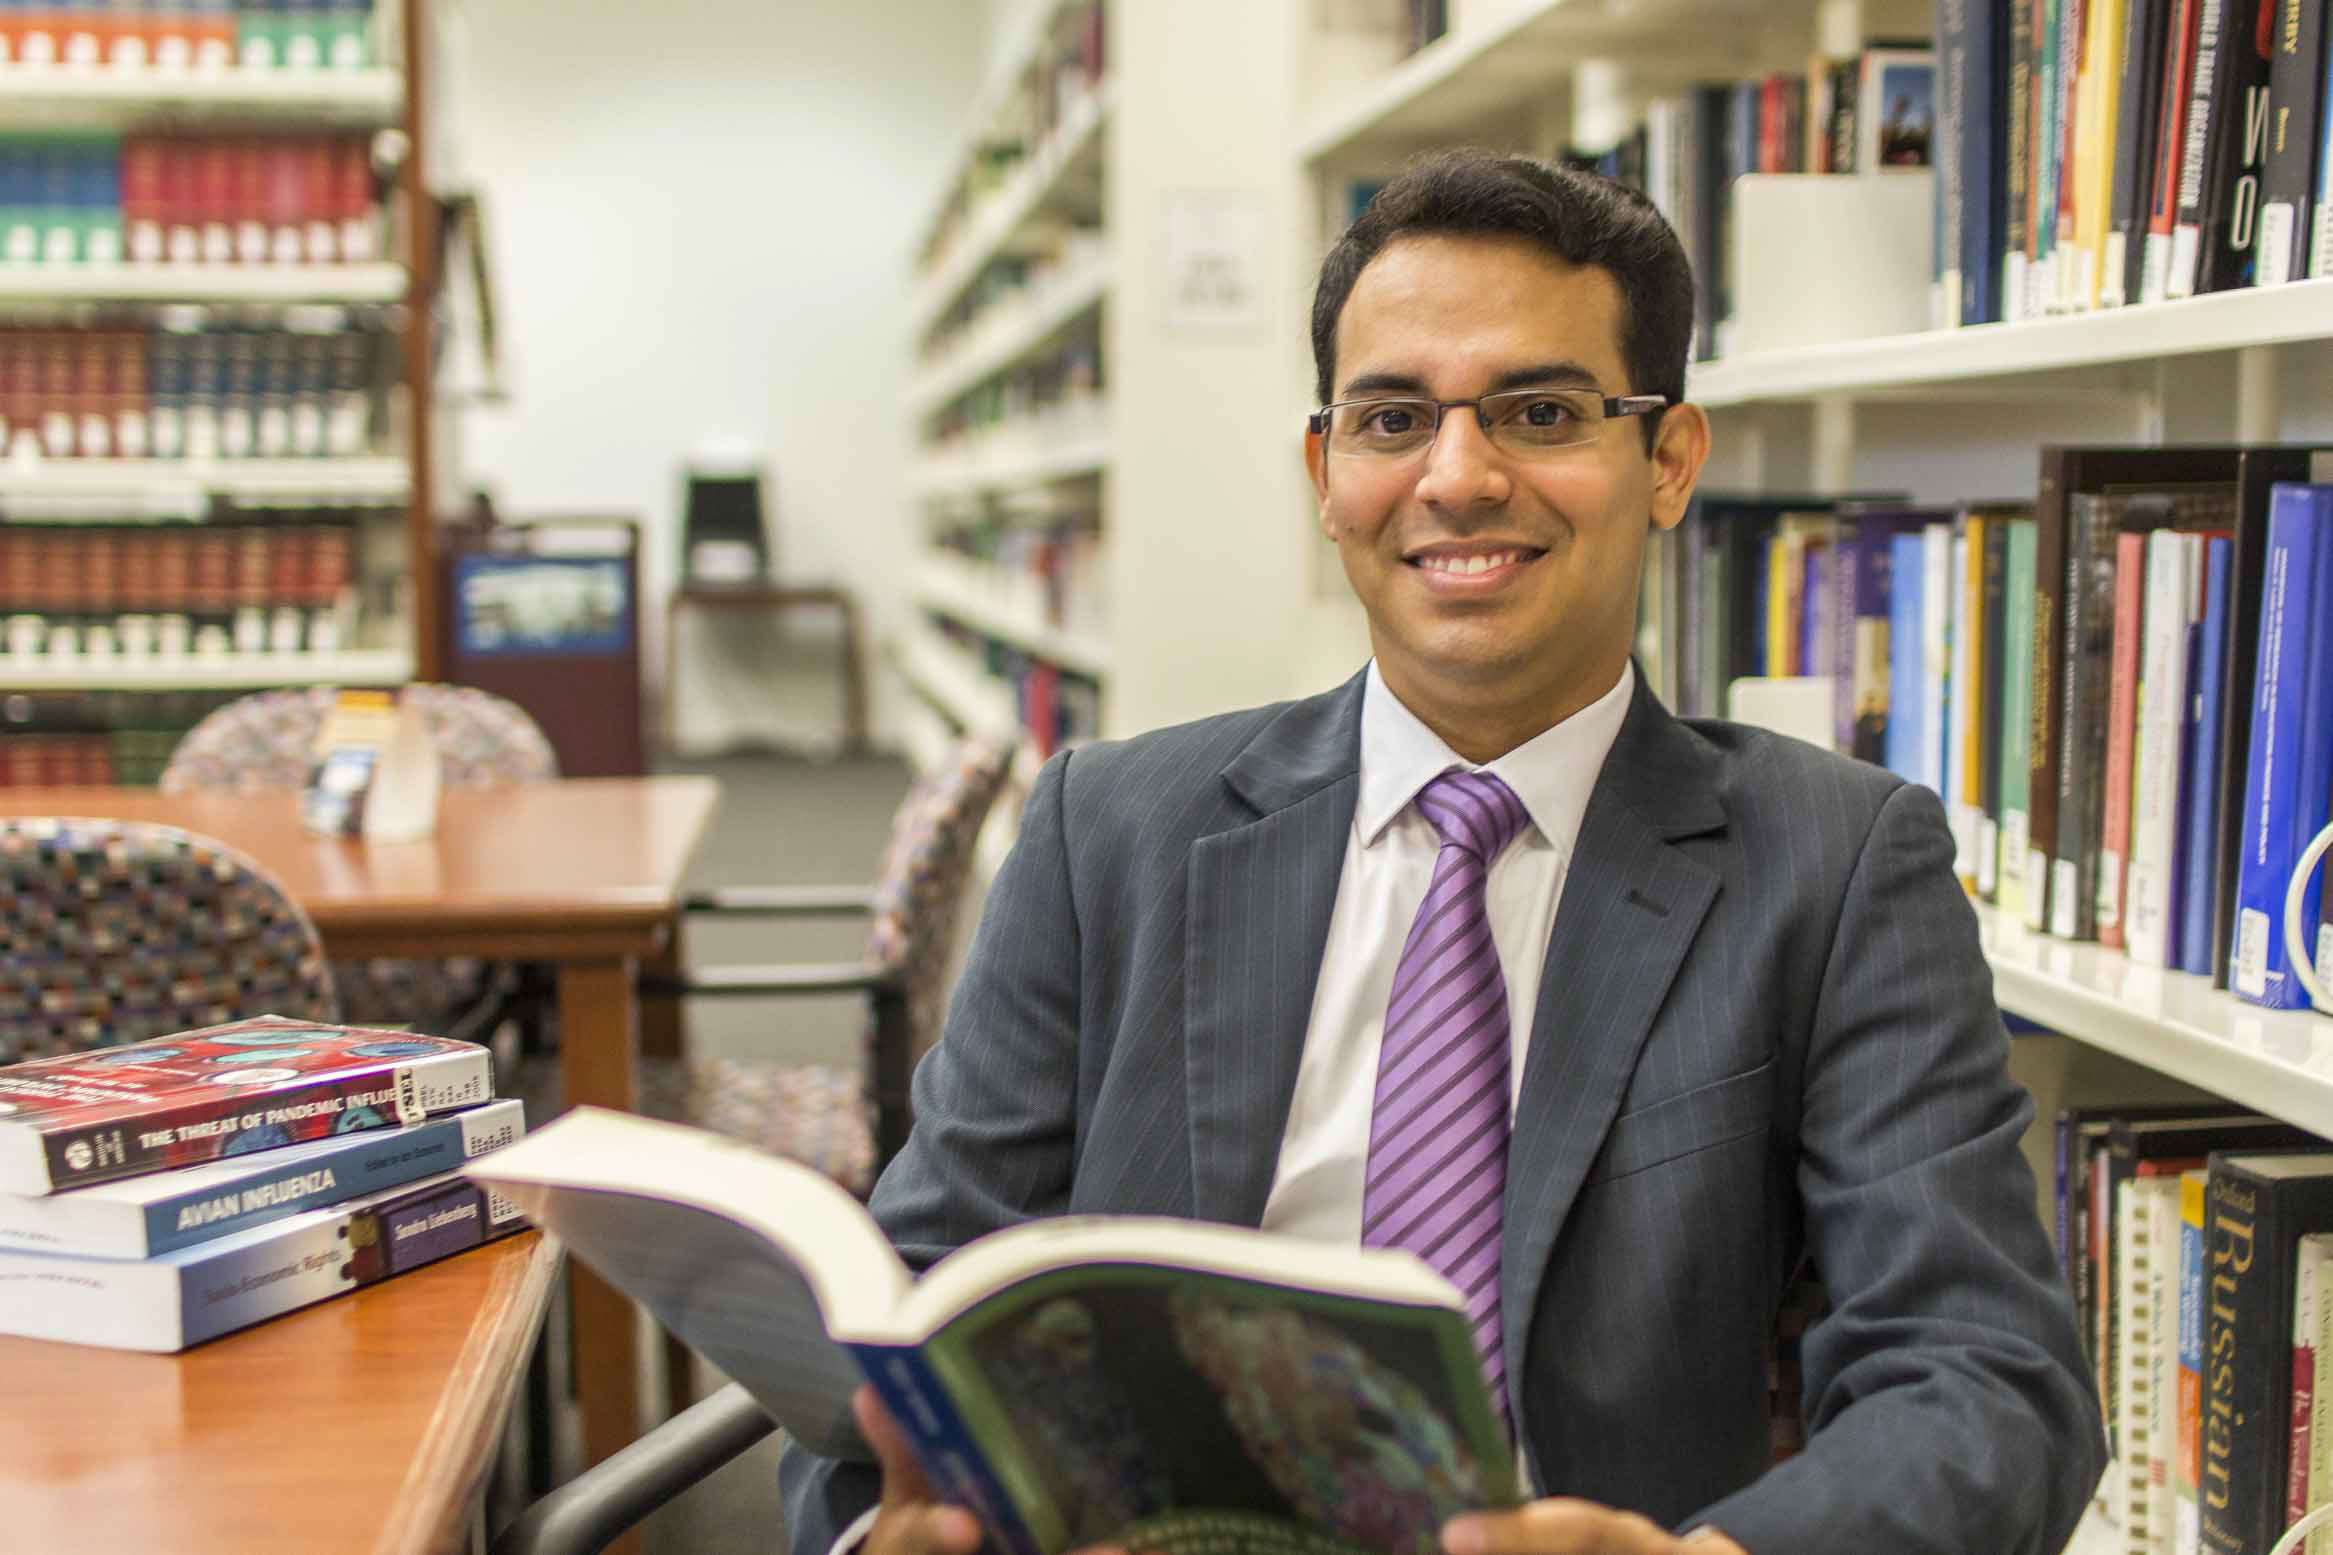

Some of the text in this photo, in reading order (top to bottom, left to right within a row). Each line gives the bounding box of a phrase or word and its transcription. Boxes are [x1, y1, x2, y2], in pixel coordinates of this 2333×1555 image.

[138, 1130, 175, 1149] THE
[176, 1116, 239, 1142] THREAT
[240, 1112, 265, 1132] OF
[265, 1097, 345, 1126] PANDEMIC
[176, 1167, 337, 1232] AVIAN INFLUENZA
[2206, 1215, 2255, 1509] Russian
